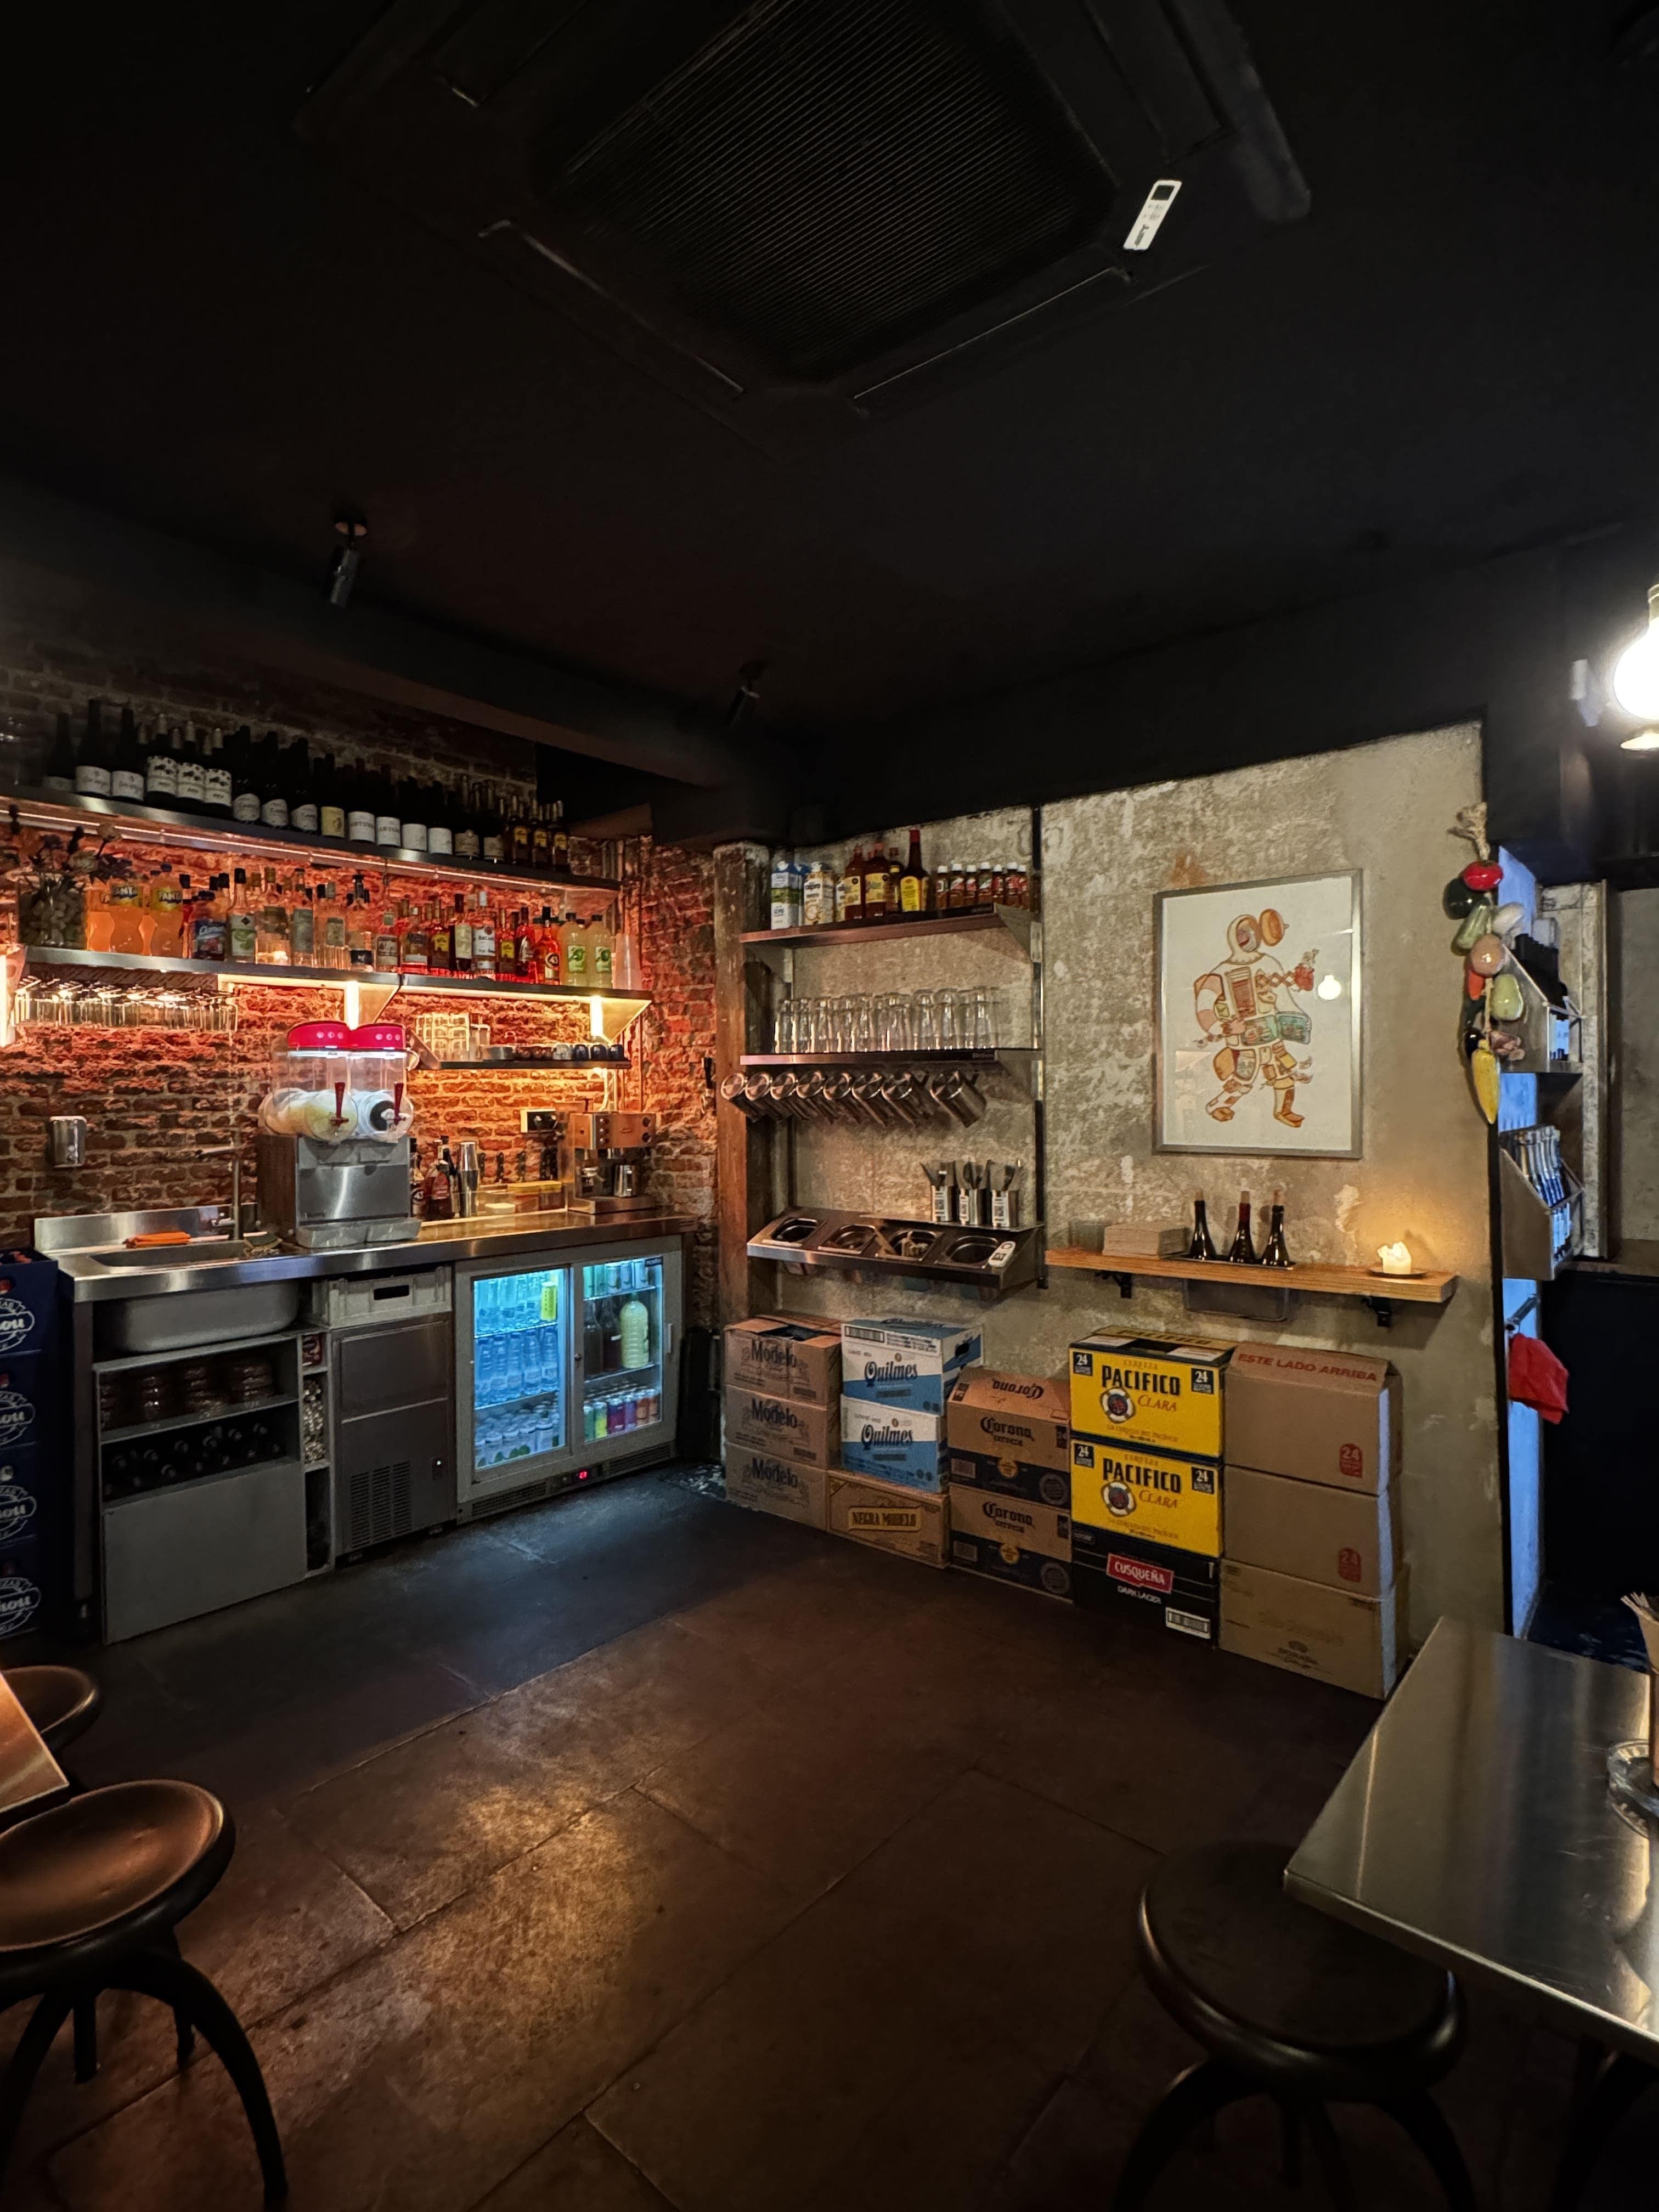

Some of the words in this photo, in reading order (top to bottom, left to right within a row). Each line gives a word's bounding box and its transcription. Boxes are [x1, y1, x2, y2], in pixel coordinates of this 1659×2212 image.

[752, 1340, 797, 1368] Modelo
[1076, 1355, 1088, 1365] 24
[865, 1361, 918, 1387] Quilmes
[1195, 1371, 1209, 1383] 24
[1238, 1353, 1272, 1365] ESTE
[1276, 1360, 1316, 1372] LADO
[1319, 1366, 1377, 1381] ARRIBA
[992, 1378, 1043, 1400] Corona
[1102, 1365, 1180, 1395] PACIFICO
[752, 1398, 798, 1429] Modelo
[1137, 1394, 1177, 1412] CLARA
[861, 1424, 913, 1450] Quilmes
[980, 1416, 1035, 1441] Corona
[1077, 1445, 1090, 1457] 24
[1341, 1445, 1361, 1461] 24
[752, 1458, 798, 1488] Modelo
[1103, 1458, 1181, 1493] PACIFICO
[1195, 1470, 1209, 1483] 24
[1139, 1490, 1178, 1509] CLARA
[852, 1511, 881, 1525] NEGRA
[982, 1501, 1036, 1528] Corona
[1114, 1561, 1165, 1585] CUSQUEÑA
[1117, 1585, 1136, 1596] DARK
